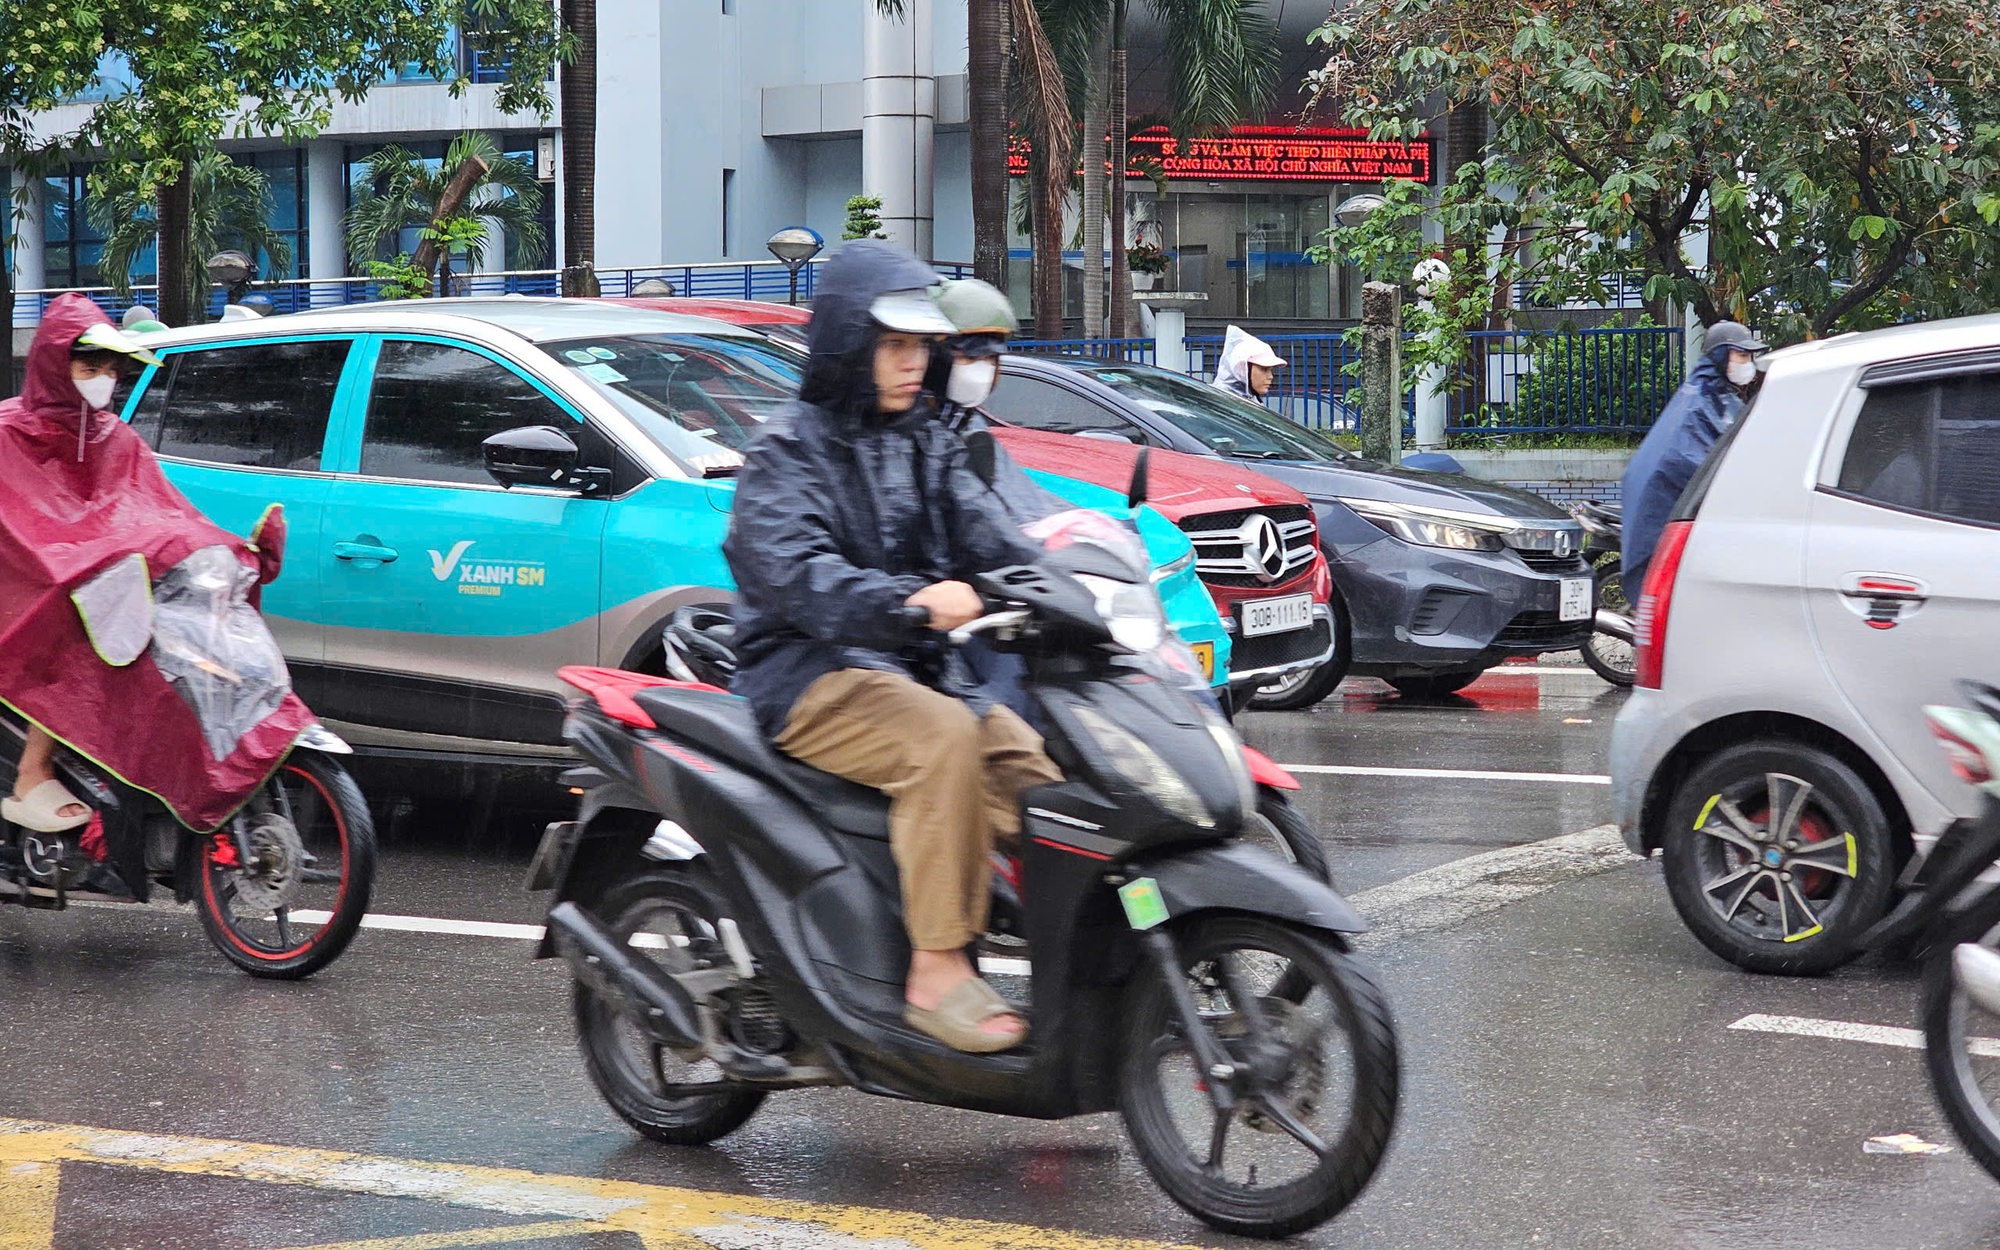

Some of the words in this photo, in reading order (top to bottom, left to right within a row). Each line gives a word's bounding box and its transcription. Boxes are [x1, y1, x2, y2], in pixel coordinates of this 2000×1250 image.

[1253, 143, 1284, 158] VIỆC
[1285, 145, 1320, 158] THEO
[1353, 143, 1387, 159] PHÁP
[1162, 155, 1201, 171] CỘNG
[1233, 157, 1253, 171] XÃ
[1254, 157, 1278, 172] HỘI
[1280, 158, 1307, 172] CHỦ
[1309, 158, 1350, 172] NGHĨA
[1351, 160, 1381, 174] VIỆT
[1383, 162, 1412, 174] NAM
[459, 564, 514, 585] XANH
[516, 566, 545, 586] SM
[458, 584, 501, 596] PREMIUM
